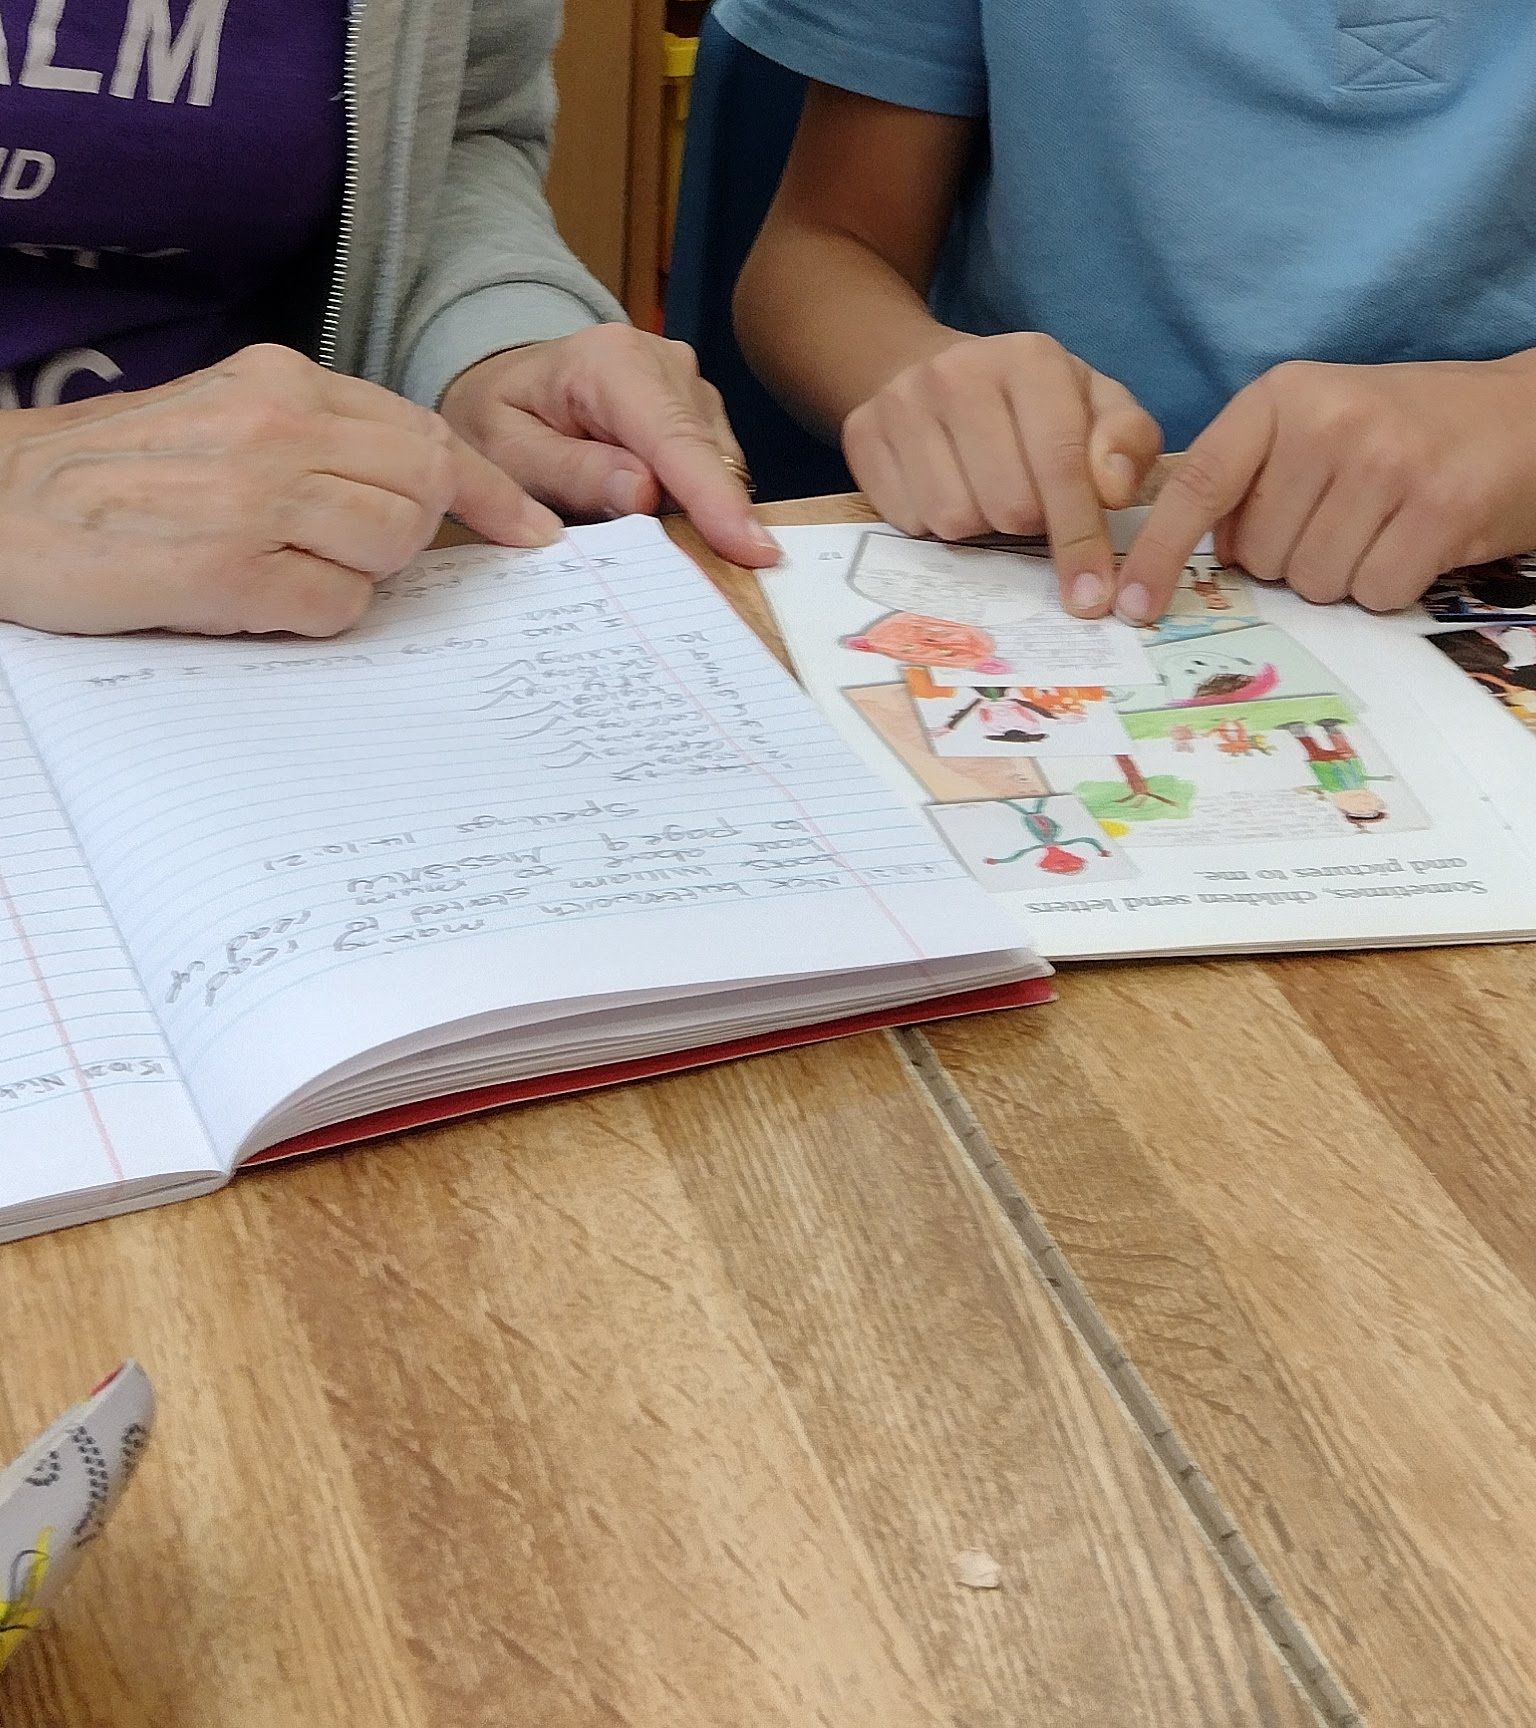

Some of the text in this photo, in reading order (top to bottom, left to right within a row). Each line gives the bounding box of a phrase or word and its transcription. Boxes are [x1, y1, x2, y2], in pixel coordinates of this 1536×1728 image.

[1290, 858, 1405, 879] pictures
[1407, 858, 1467, 875] and
[1255, 869, 1289, 881] to
[1023, 898, 1119, 914] letters
[1119, 894, 1192, 912] send
[1196, 890, 1318, 906] children
